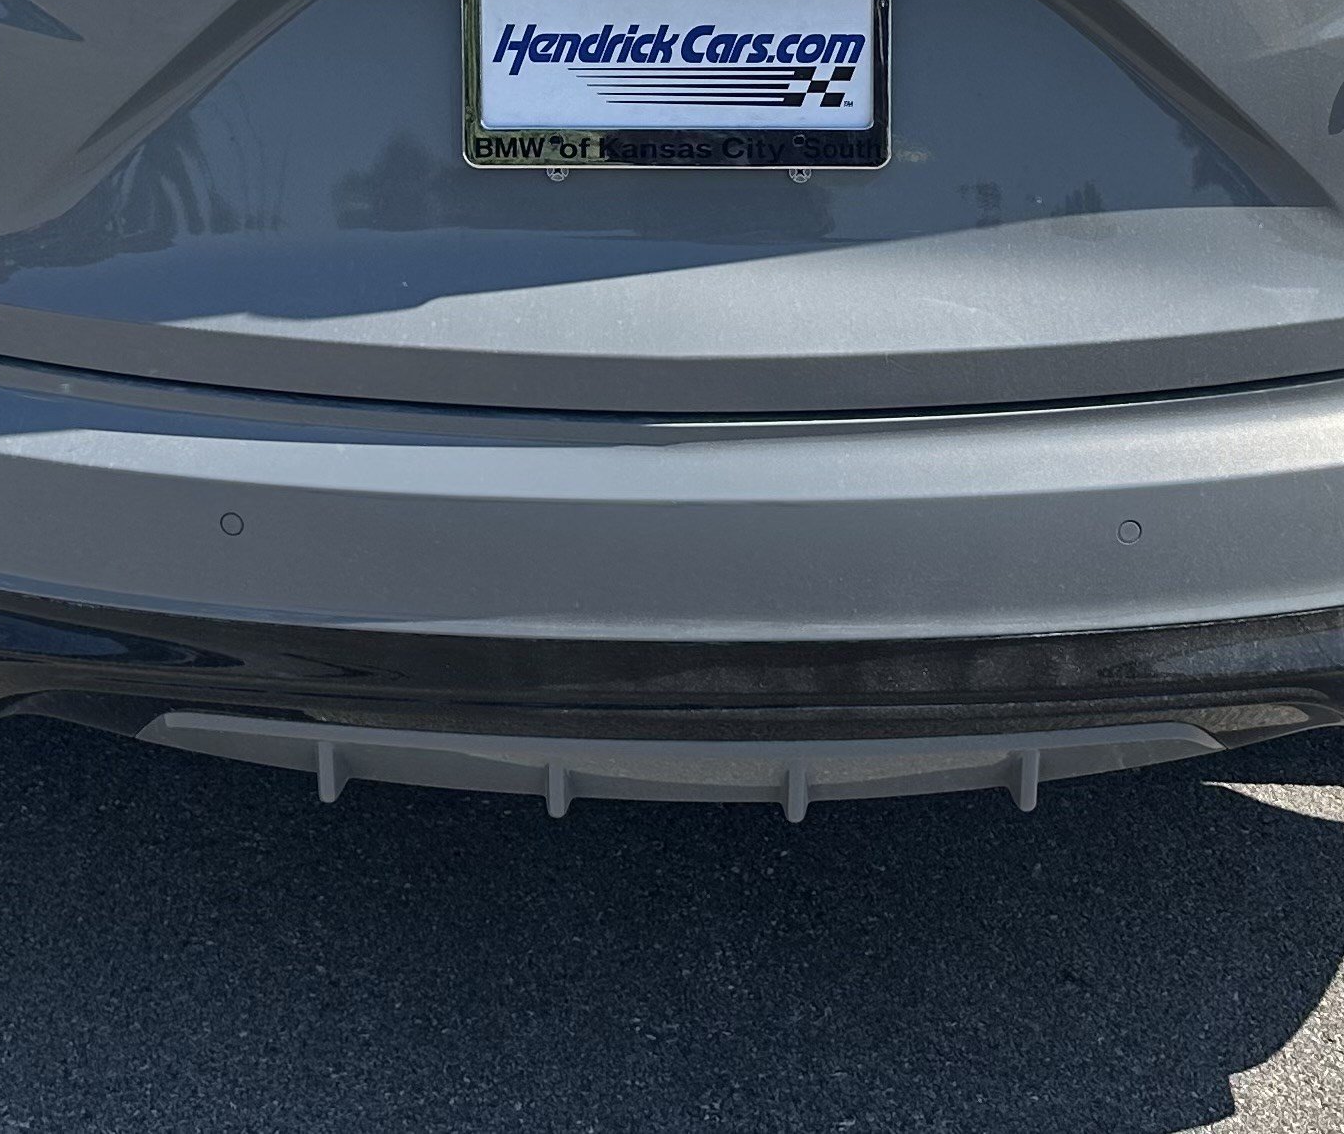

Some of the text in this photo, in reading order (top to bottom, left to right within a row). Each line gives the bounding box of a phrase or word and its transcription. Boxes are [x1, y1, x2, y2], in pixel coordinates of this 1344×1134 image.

[474, 136, 882, 164] BMW of Kansas City South
